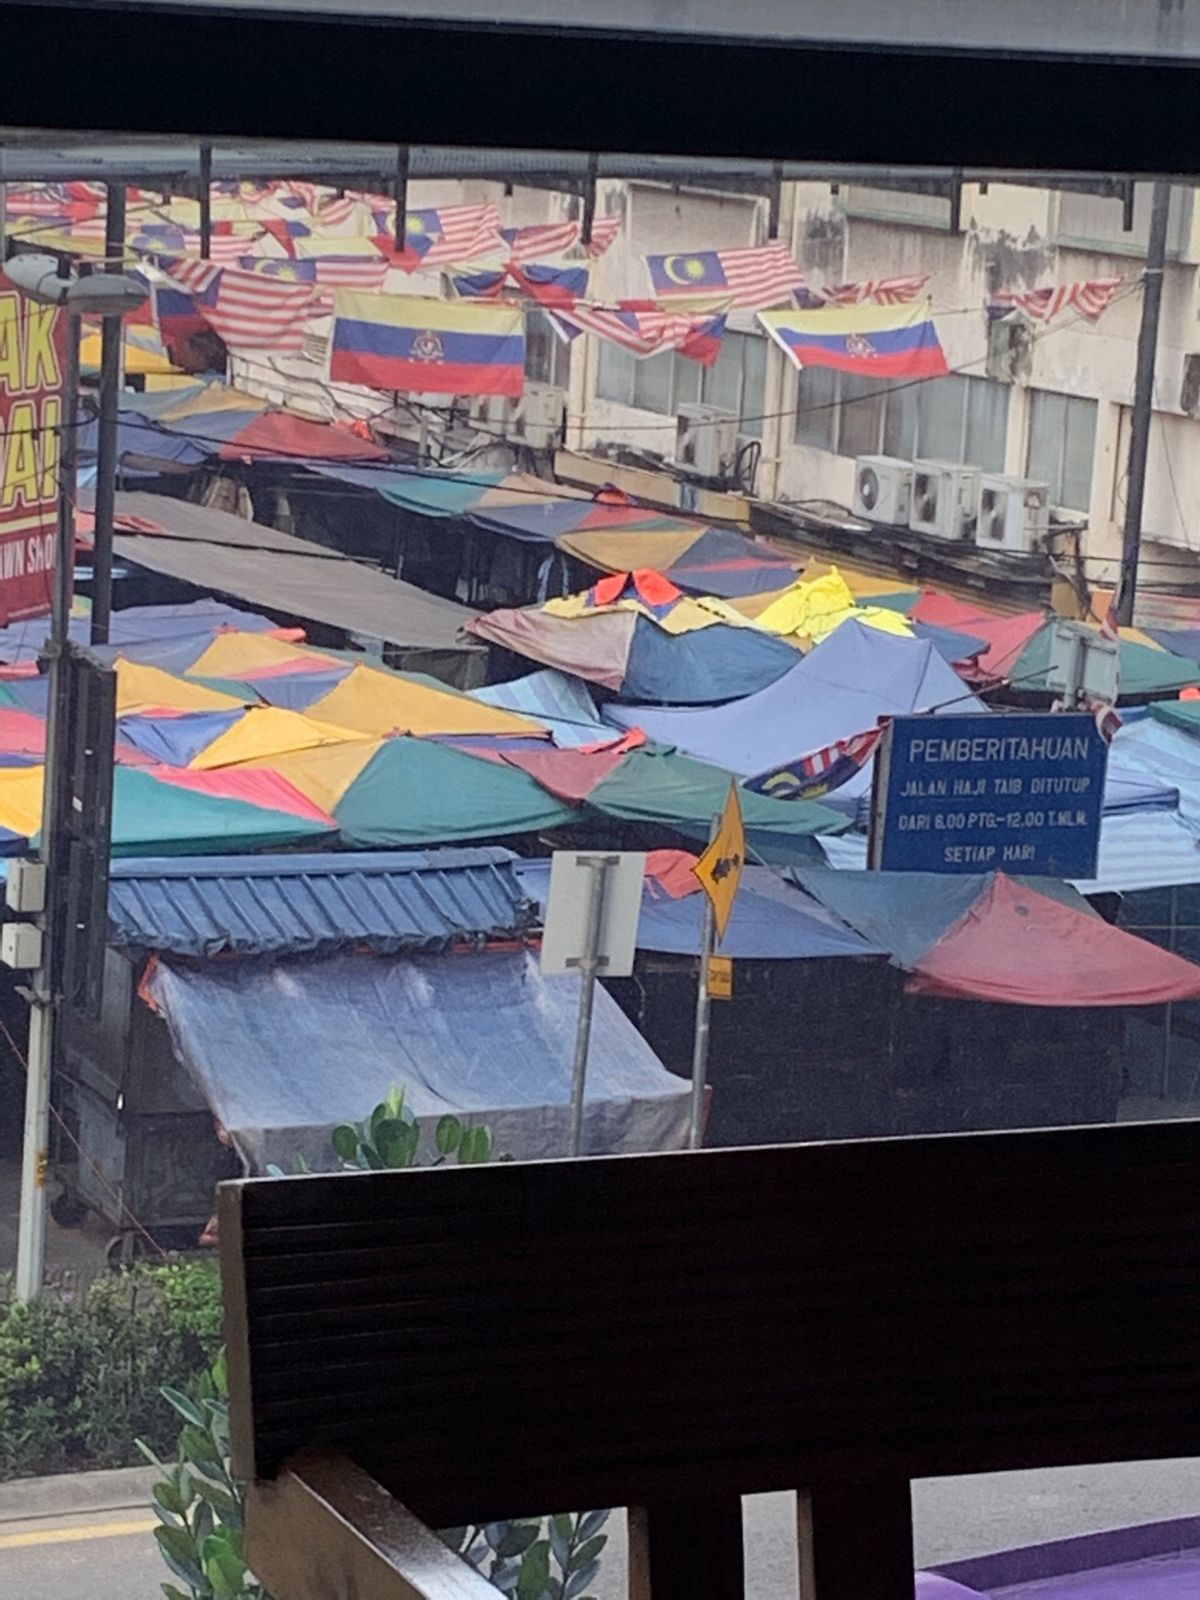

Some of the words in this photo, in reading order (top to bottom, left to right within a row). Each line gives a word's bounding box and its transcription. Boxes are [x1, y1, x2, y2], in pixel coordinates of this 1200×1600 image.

[0, 397, 60, 509] AI
[0, 540, 25, 579] WN
[909, 737, 1089, 762] PEMBERITAHUAN
[900, 780, 946, 796] JALAN
[953, 779, 986, 795] HAJI
[994, 778, 1022, 794] TAIB
[1030, 777, 1090, 794] DITUTUP
[898, 814, 930, 831] DARI
[944, 846, 996, 862] SETIAP
[1002, 845, 1036, 861] HARI
